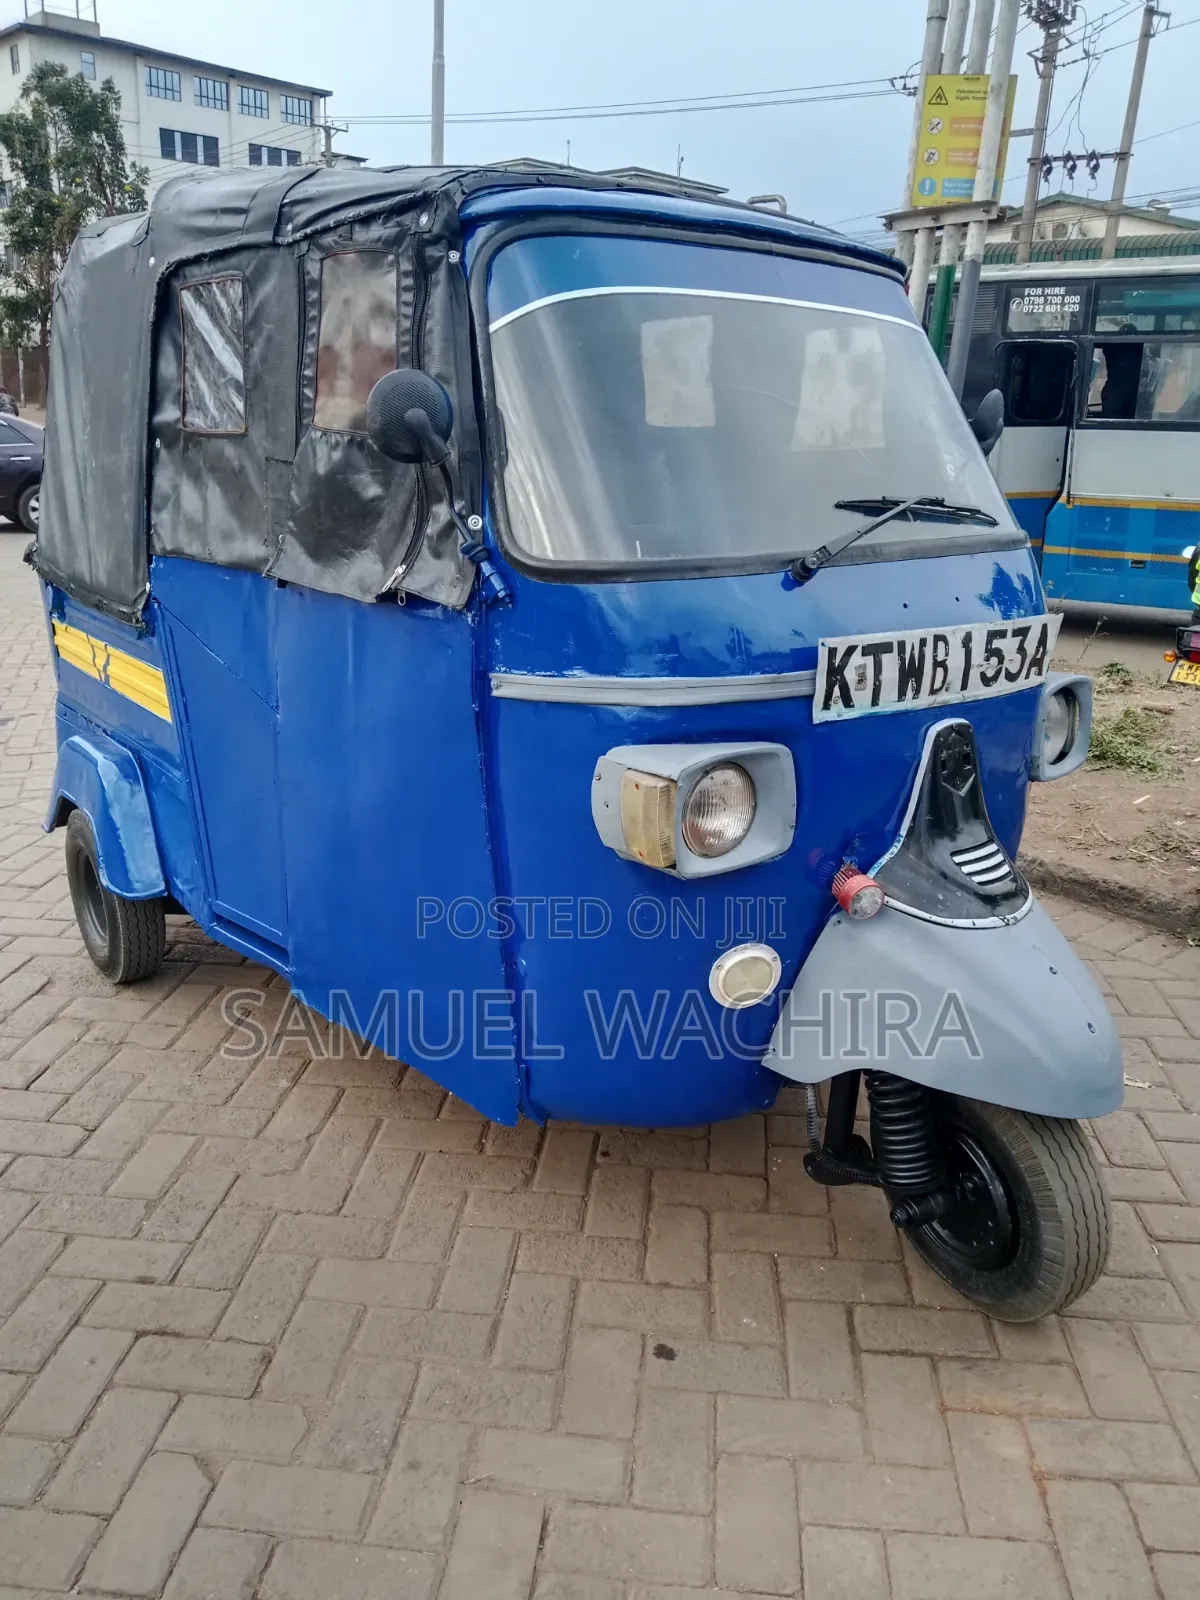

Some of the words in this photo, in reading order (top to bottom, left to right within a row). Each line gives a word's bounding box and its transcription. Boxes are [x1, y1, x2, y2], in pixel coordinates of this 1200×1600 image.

[1024, 287, 1042, 296] FOR
[1044, 286, 1066, 295] HIRE
[1023, 296, 1044, 305] 0798
[1046, 296, 1062, 304] 700
[1064, 295, 1080, 304] 000
[1022, 304, 1043, 313] 0722
[1045, 304, 1060, 312] 601
[1063, 303, 1079, 312] 420
